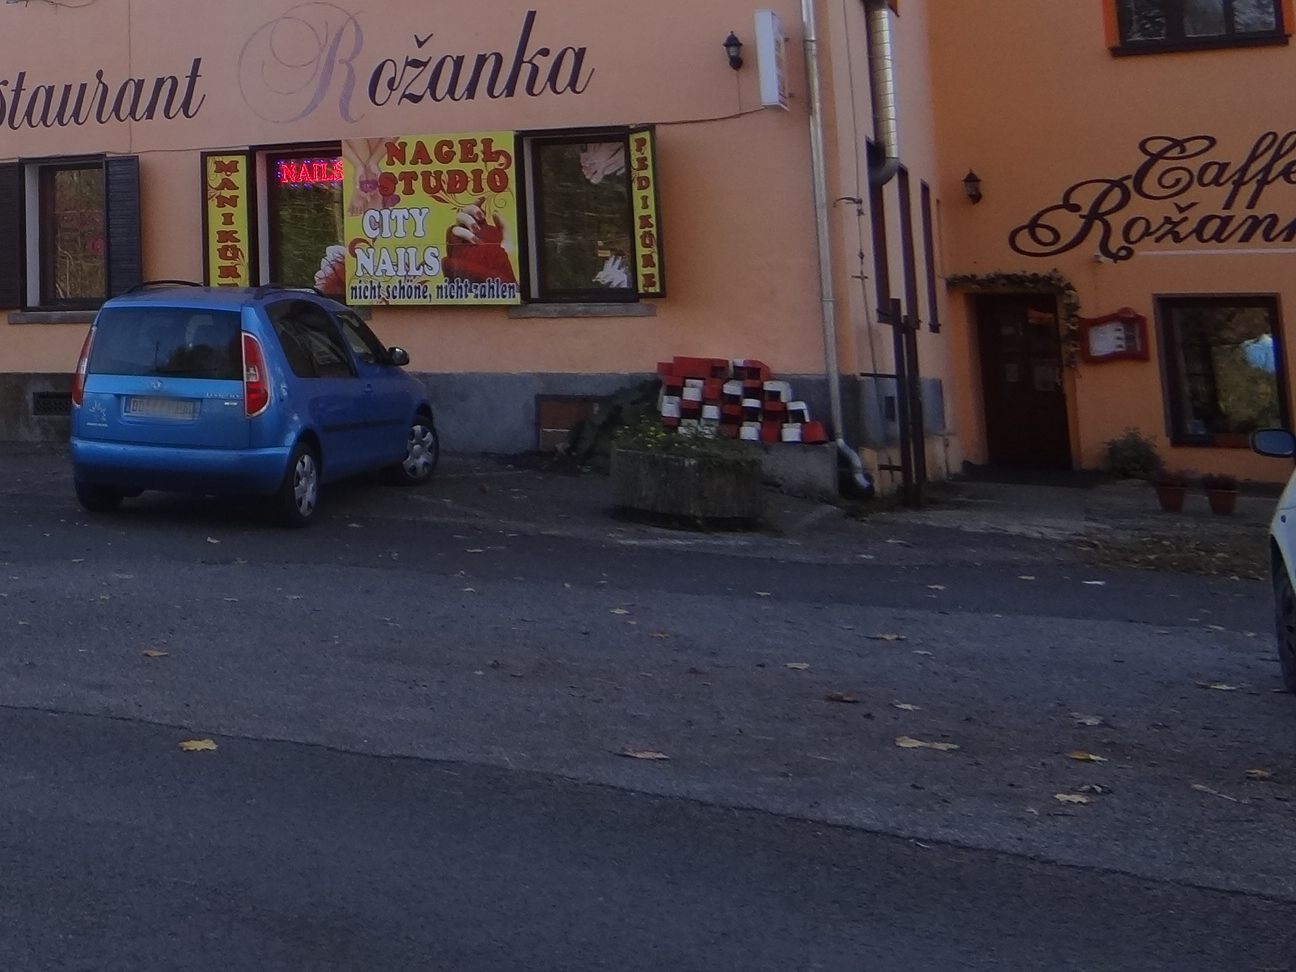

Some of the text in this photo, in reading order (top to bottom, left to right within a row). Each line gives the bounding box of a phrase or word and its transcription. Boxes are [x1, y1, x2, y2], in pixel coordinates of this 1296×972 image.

[238, 2, 594, 123] Rožanka
[384, 137, 502, 167] NAGEL
[279, 160, 344, 184] NAILS
[378, 167, 510, 196] STUDIO
[213, 159, 242, 288] MANIKÜR
[362, 206, 430, 239] CITY
[633, 136, 657, 288] PEDIKÜRE
[354, 245, 441, 278] NAILS
[350, 277, 517, 303] nicht schöne, nicht zahlen
